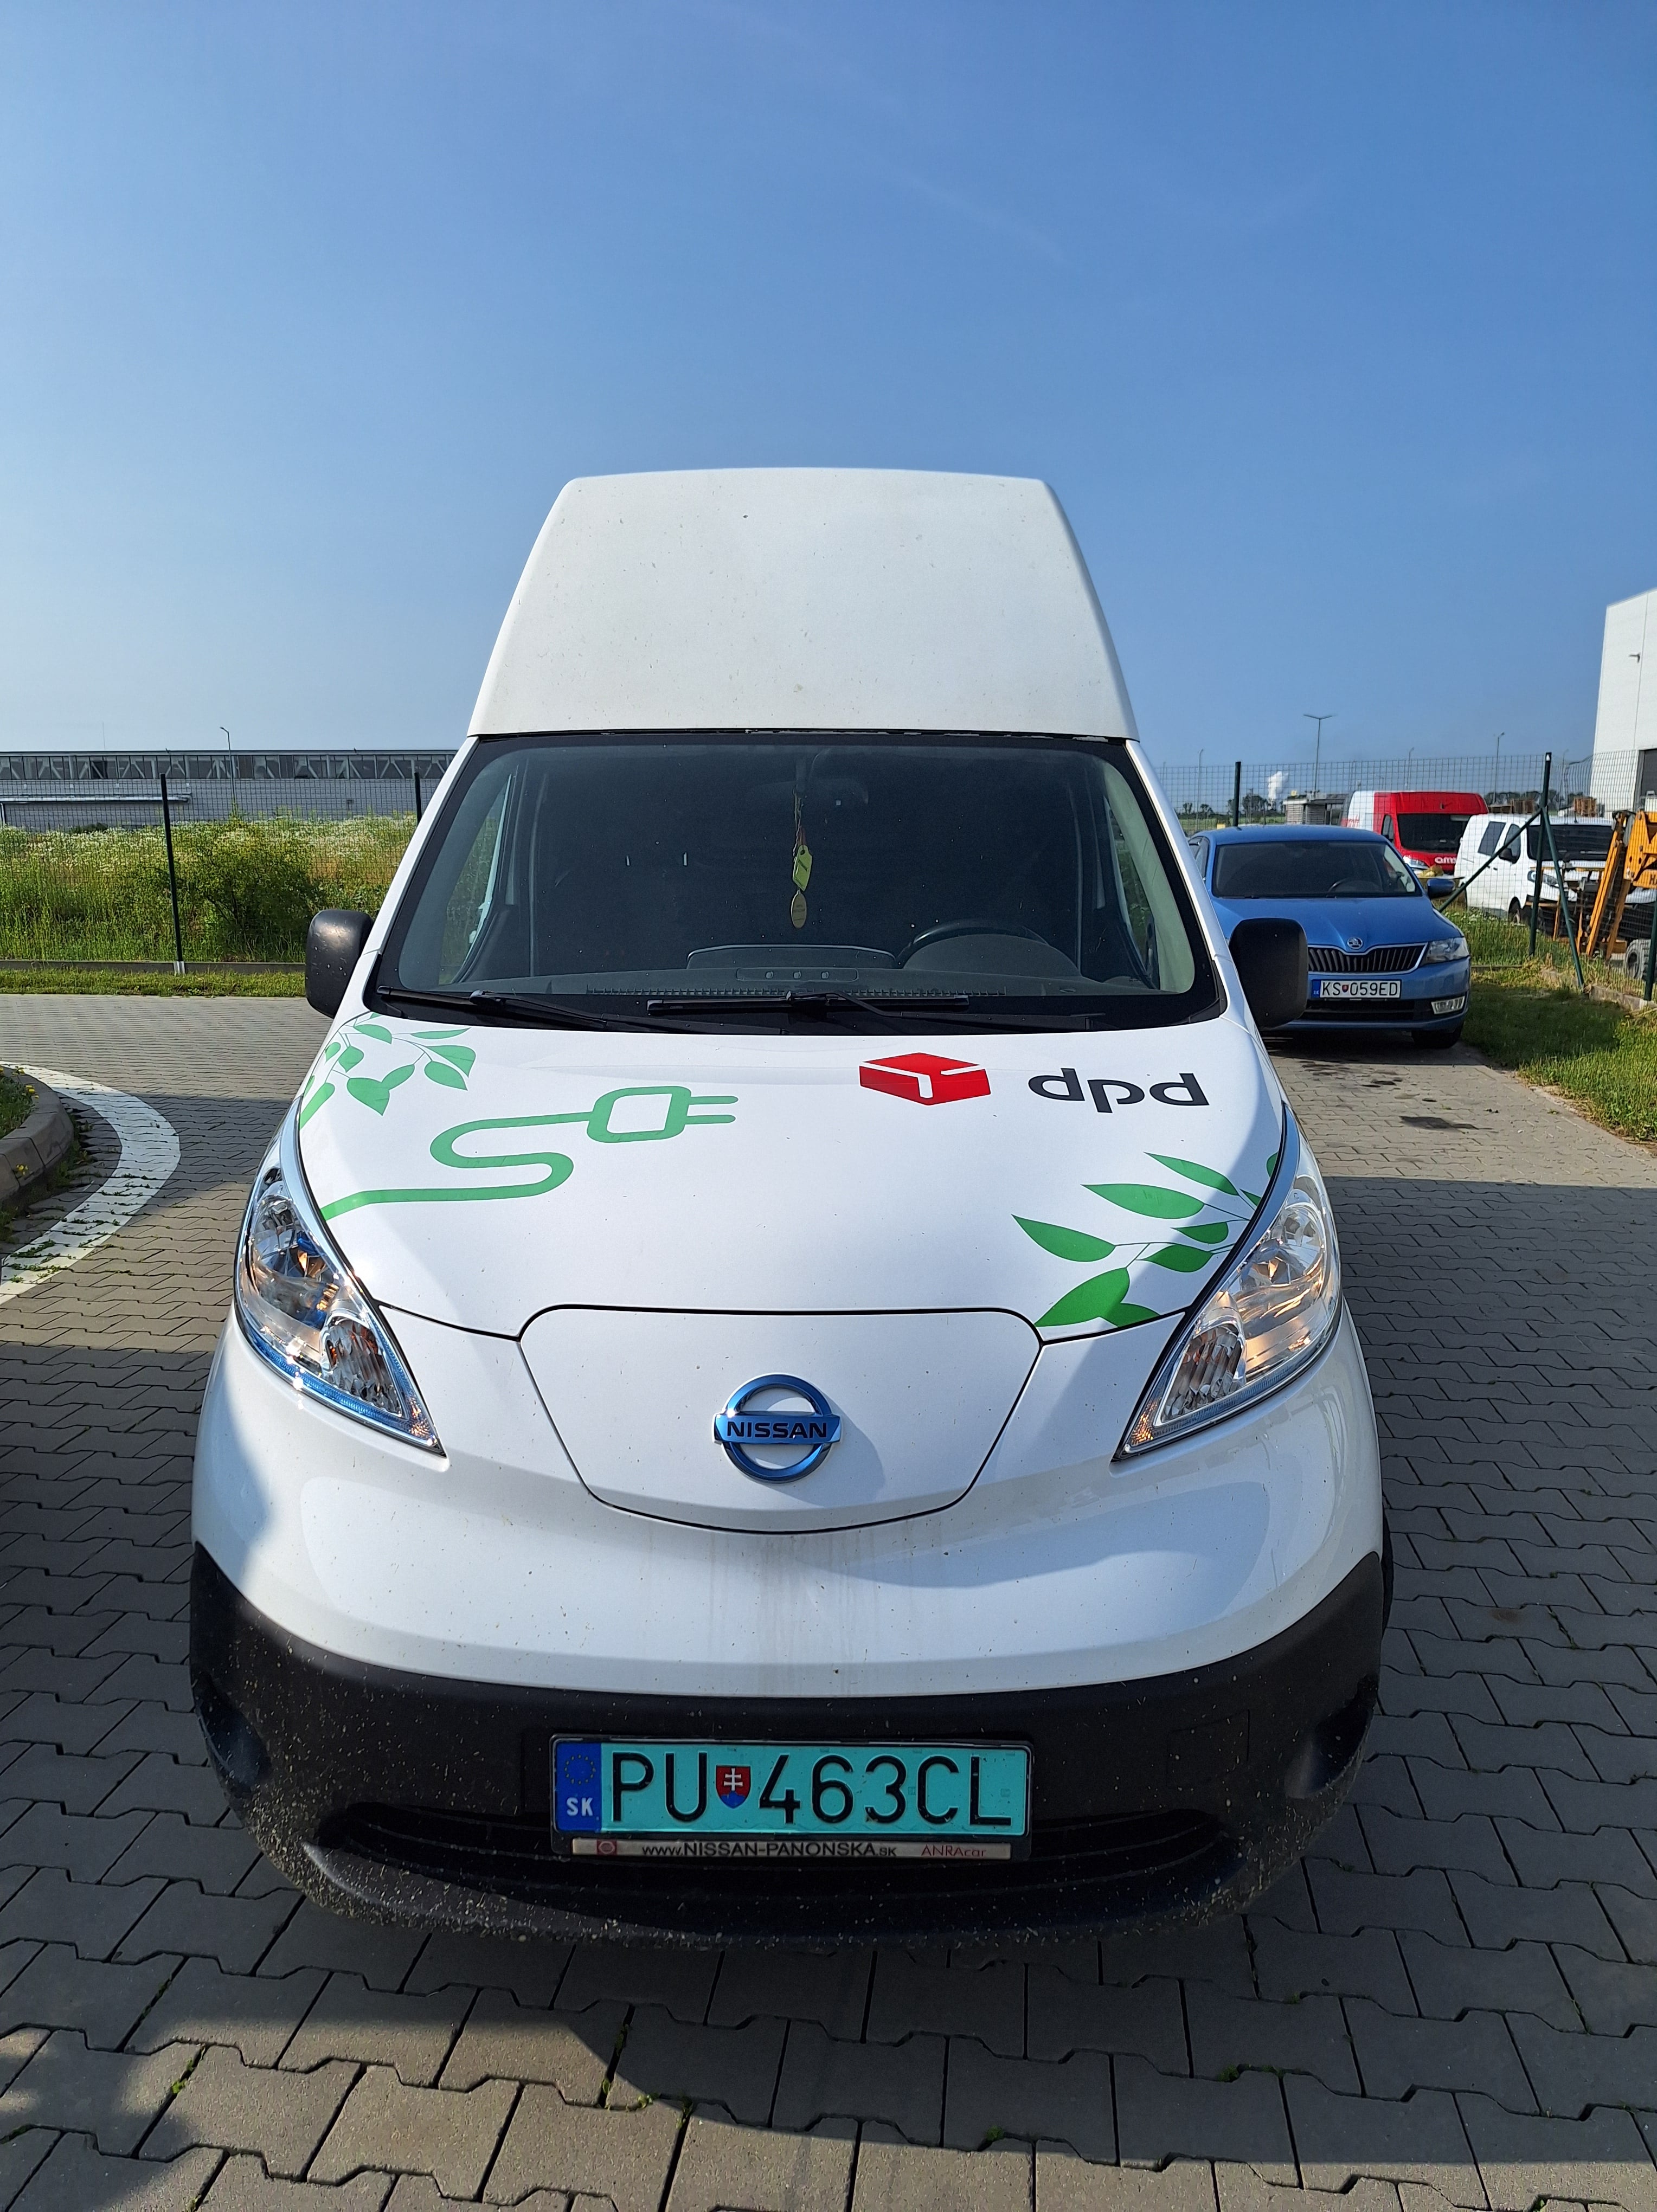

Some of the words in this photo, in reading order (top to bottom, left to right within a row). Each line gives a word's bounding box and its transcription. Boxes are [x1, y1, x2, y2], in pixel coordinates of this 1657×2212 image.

[1322, 982, 1341, 995] KS
[1350, 982, 1398, 996] 059ED
[1028, 1068, 1210, 1113] dpd
[727, 1422, 827, 1438] NISSAN
[613, 1752, 708, 1822] PU
[759, 1754, 1011, 1825] 463CL
[567, 1797, 593, 1816] SK
[922, 1844, 987, 1858] ANRAcar
